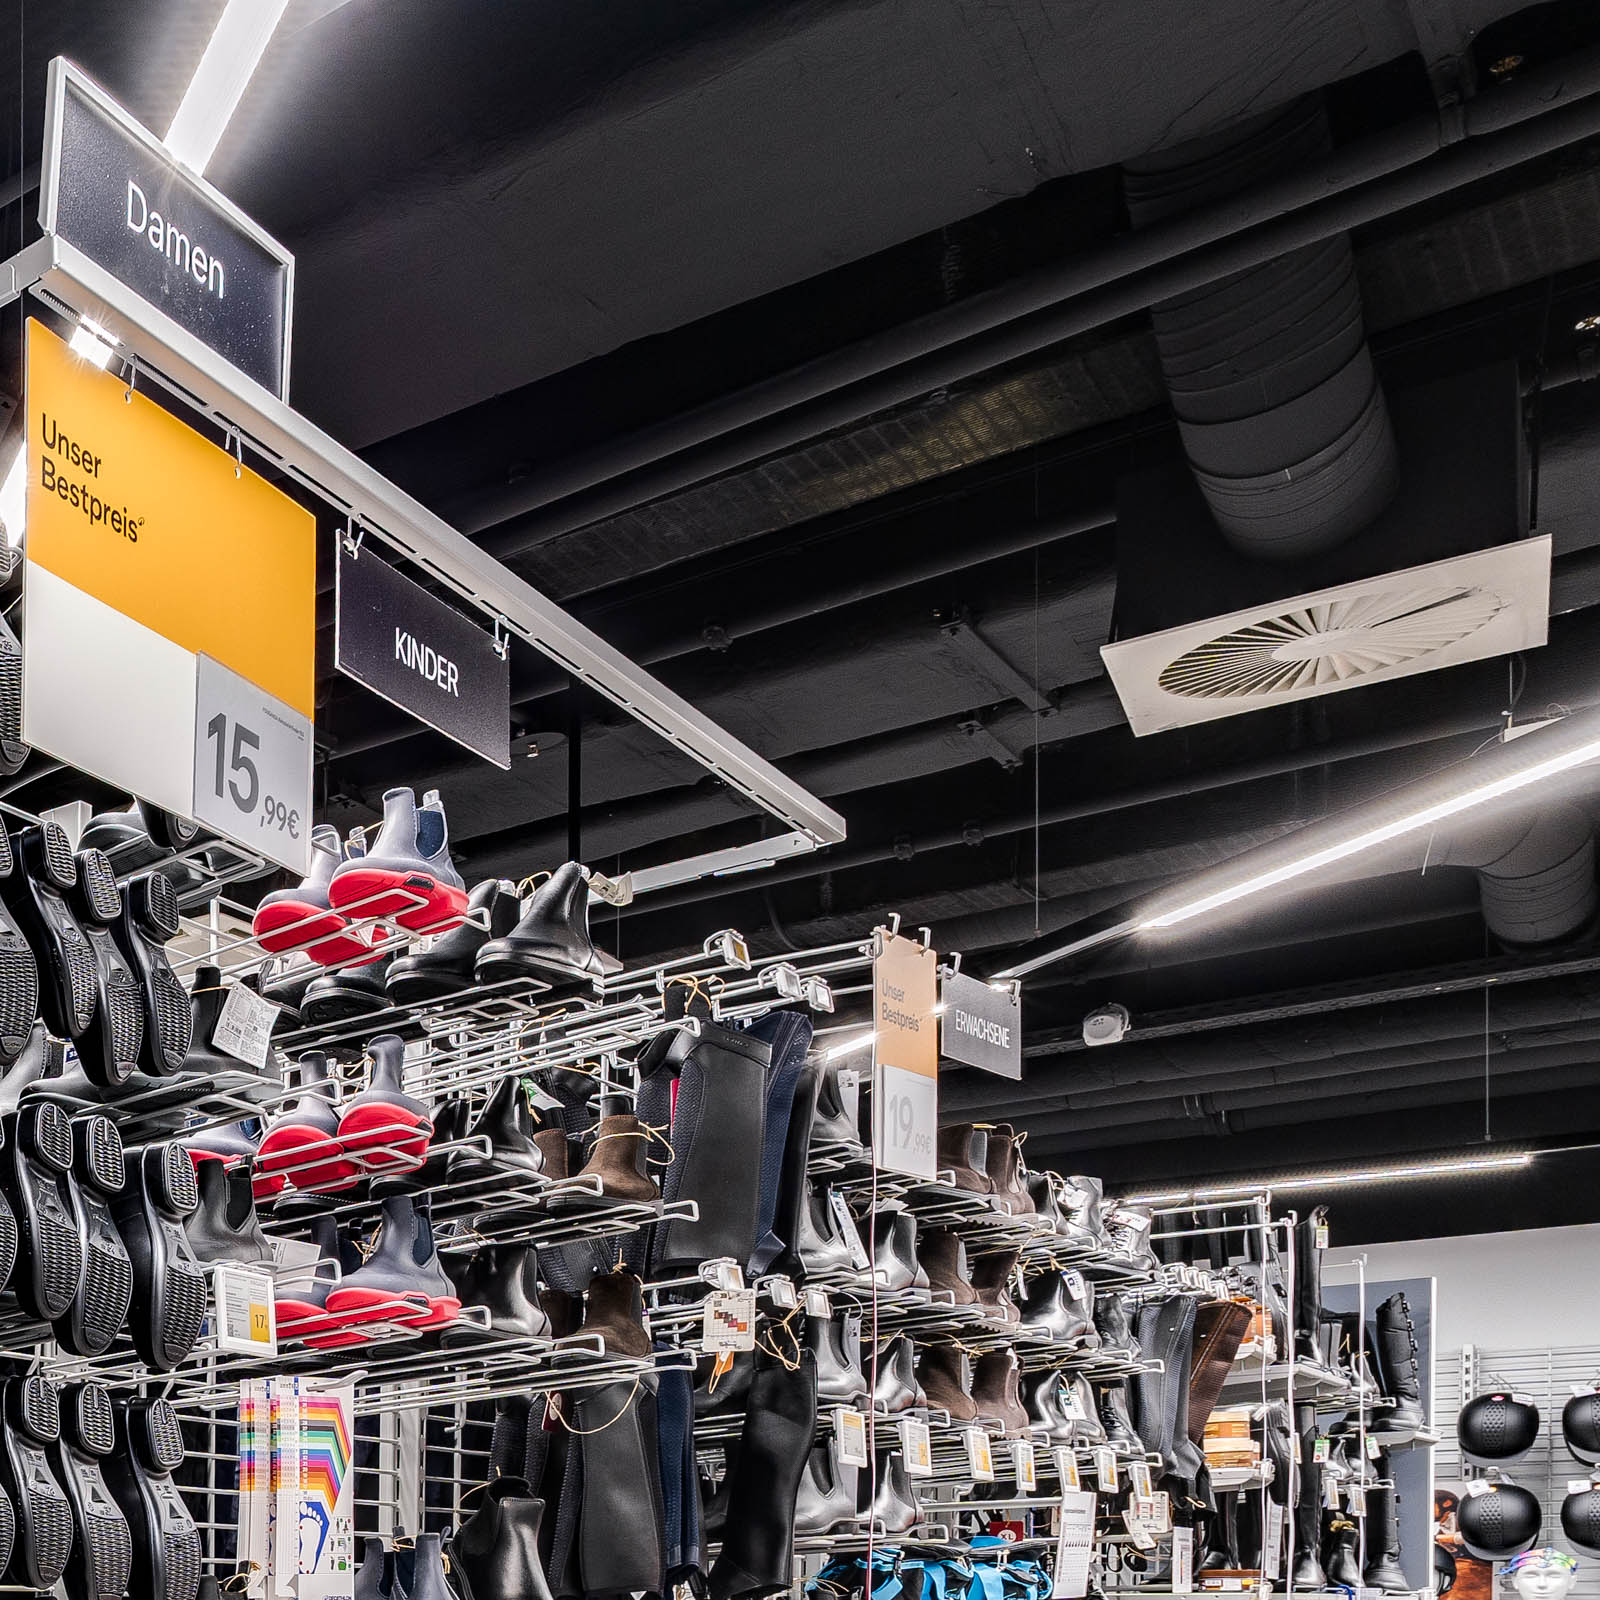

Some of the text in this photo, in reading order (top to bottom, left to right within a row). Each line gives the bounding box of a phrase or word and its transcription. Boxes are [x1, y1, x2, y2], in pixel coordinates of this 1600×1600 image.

[126, 181, 225, 300] Damen
[41, 414, 102, 479] Unser
[41, 455, 140, 544] Bestpreis
[395, 629, 459, 698] KINDER
[881, 978, 905, 1002] Unser
[881, 1003, 920, 1033] Bestpreis
[955, 1009, 1011, 1049] ERWACHSENE
[999, 1532, 1015, 1542] XL
